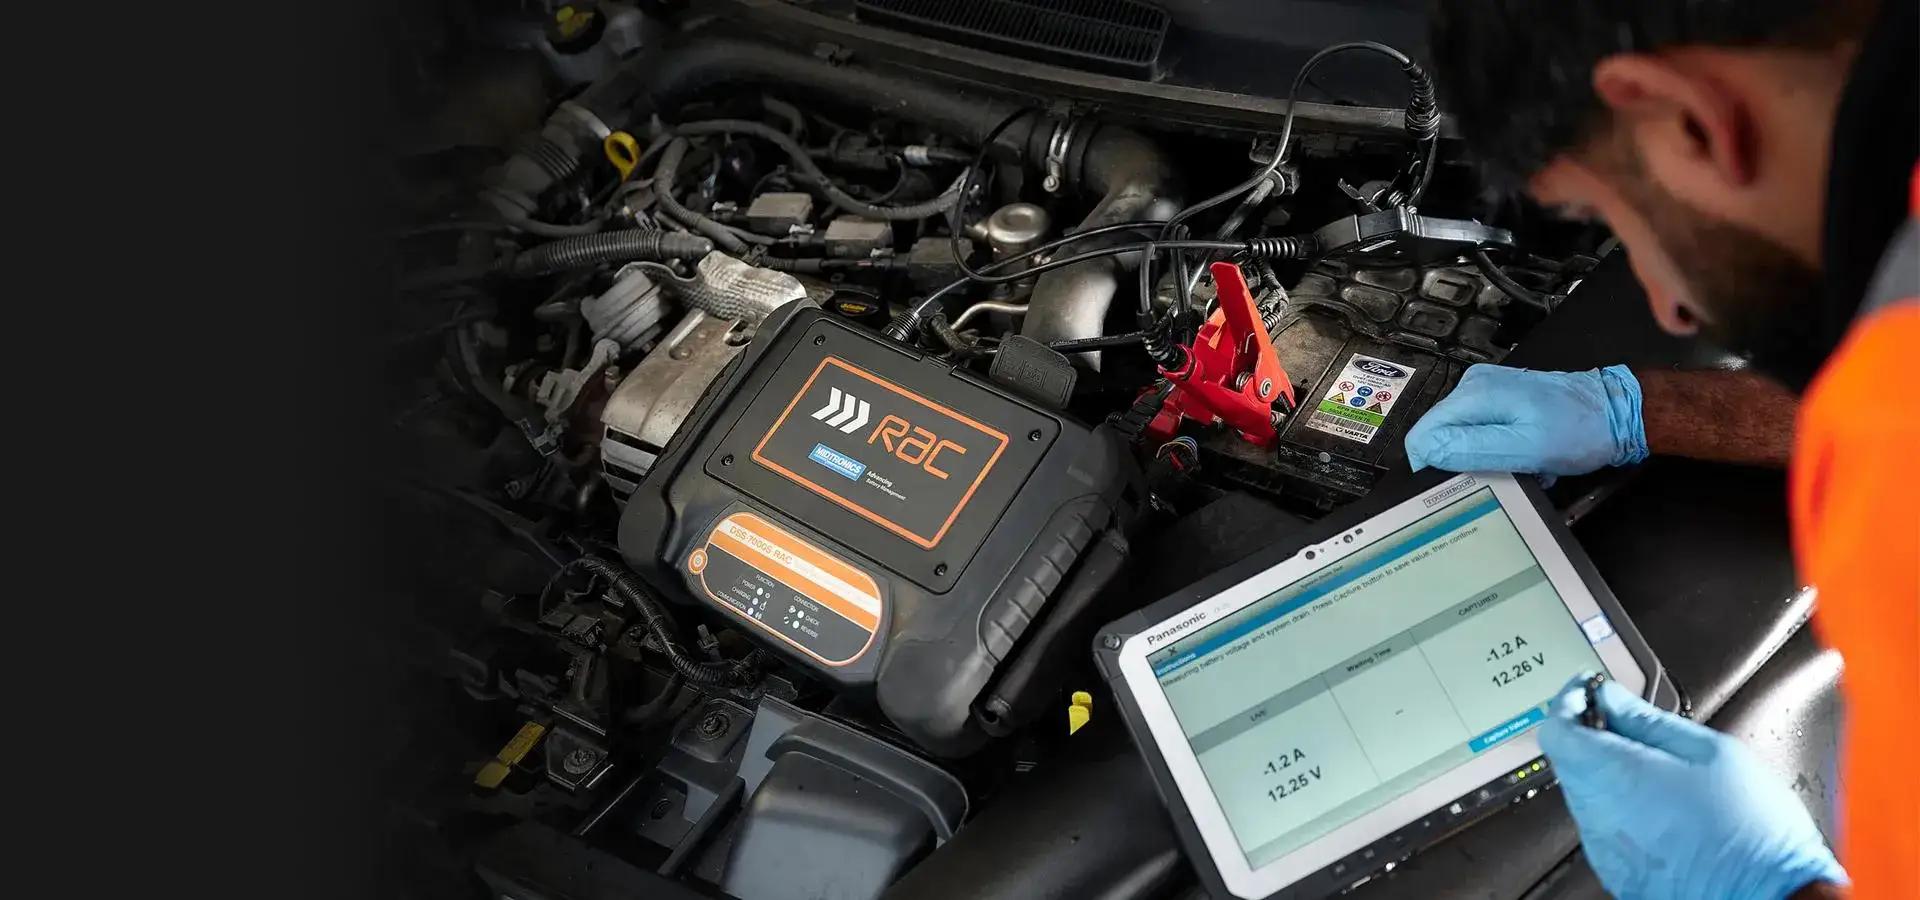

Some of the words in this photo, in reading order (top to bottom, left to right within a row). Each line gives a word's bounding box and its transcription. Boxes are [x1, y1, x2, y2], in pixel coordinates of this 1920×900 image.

[1362, 361, 1398, 377] Ford
[1344, 429, 1368, 439] VARTA
[815, 447, 862, 474] MIDTRONICS
[867, 471, 892, 487] Advancing
[1426, 479, 1472, 505] TOUGHBOOK
[742, 580, 756, 590] POWER
[756, 574, 775, 588] FUNCTION
[1162, 665, 1199, 687] Measuring
[1200, 654, 1224, 670] battery
[1225, 640, 1250, 657] voltage
[1251, 632, 1265, 643] and
[1266, 620, 1292, 636] system
[1312, 599, 1333, 611] Press
[1334, 584, 1360, 601] Capture
[1362, 573, 1385, 588] button
[1393, 560, 1410, 571] save
[1432, 541, 1448, 553] then
[1458, 592, 1498, 616] CAPTURED
[800, 625, 819, 638] REVERSE
[805, 615, 820, 626] CHECK
[1147, 612, 1207, 645] Panasonic
[1346, 657, 1374, 672] Waiting
[1374, 648, 1391, 659] Time
[1486, 642, 1513, 662] -1.2
[1515, 635, 1528, 650] A
[1492, 660, 1533, 688] 12.26
[1532, 653, 1544, 666] V
[1250, 710, 1267, 722] LIVE
[1483, 726, 1509, 745] Capture
[1509, 716, 1530, 732] Values
[1264, 754, 1291, 776] -1.2
[1293, 748, 1306, 762] A
[1268, 774, 1309, 802] 12.25
[1309, 766, 1321, 780] V
